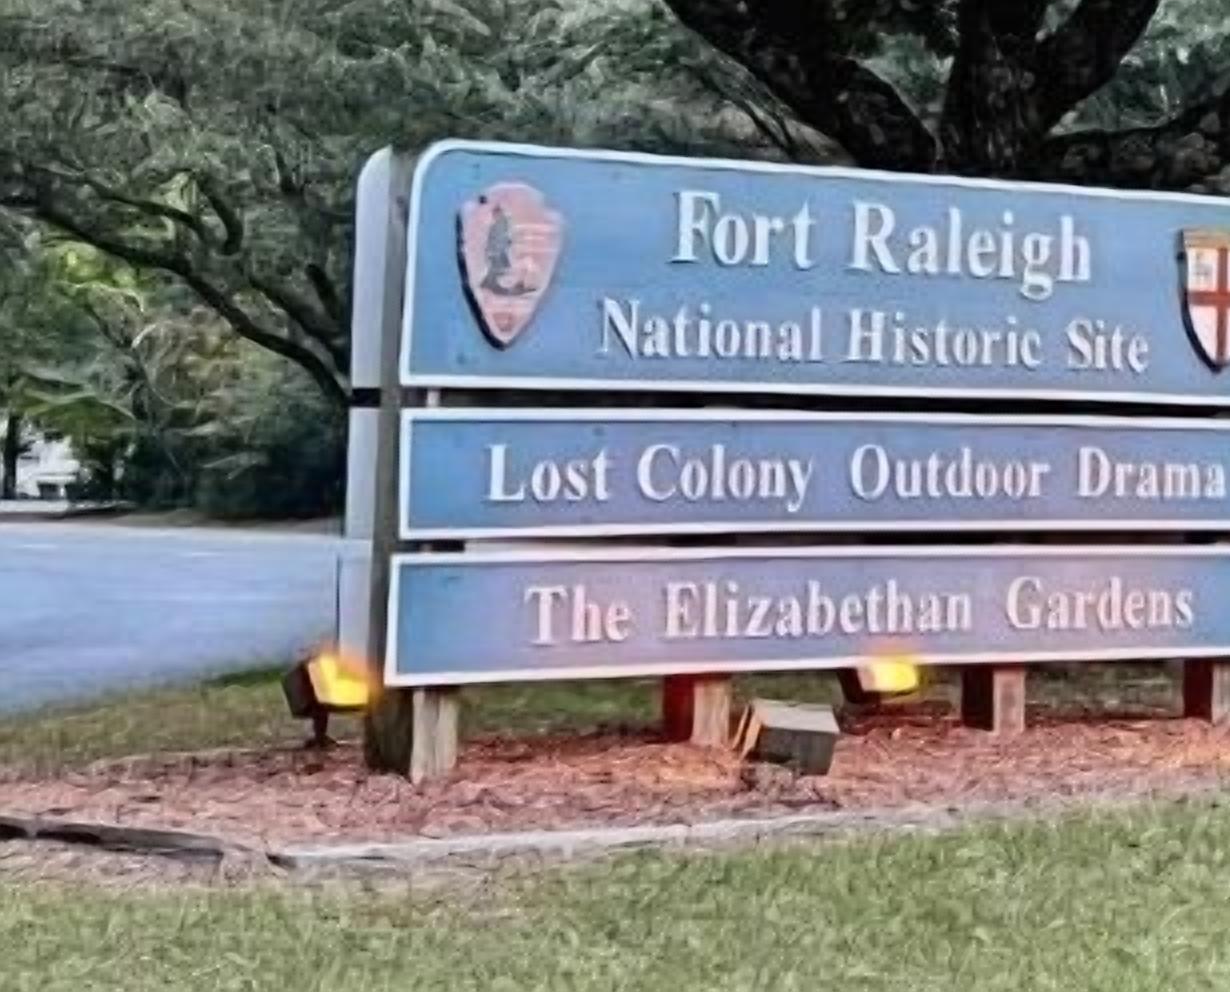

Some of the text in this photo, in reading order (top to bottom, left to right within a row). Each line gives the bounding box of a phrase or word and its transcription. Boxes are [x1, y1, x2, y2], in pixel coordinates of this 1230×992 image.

[670, 189, 1092, 300] Fort Raleigh
[600, 297, 1150, 374] National Historic Site
[488, 444, 1228, 512] Lost Colony Outdoor Drama
[525, 576, 1195, 646] The Elizabethan Gardens
